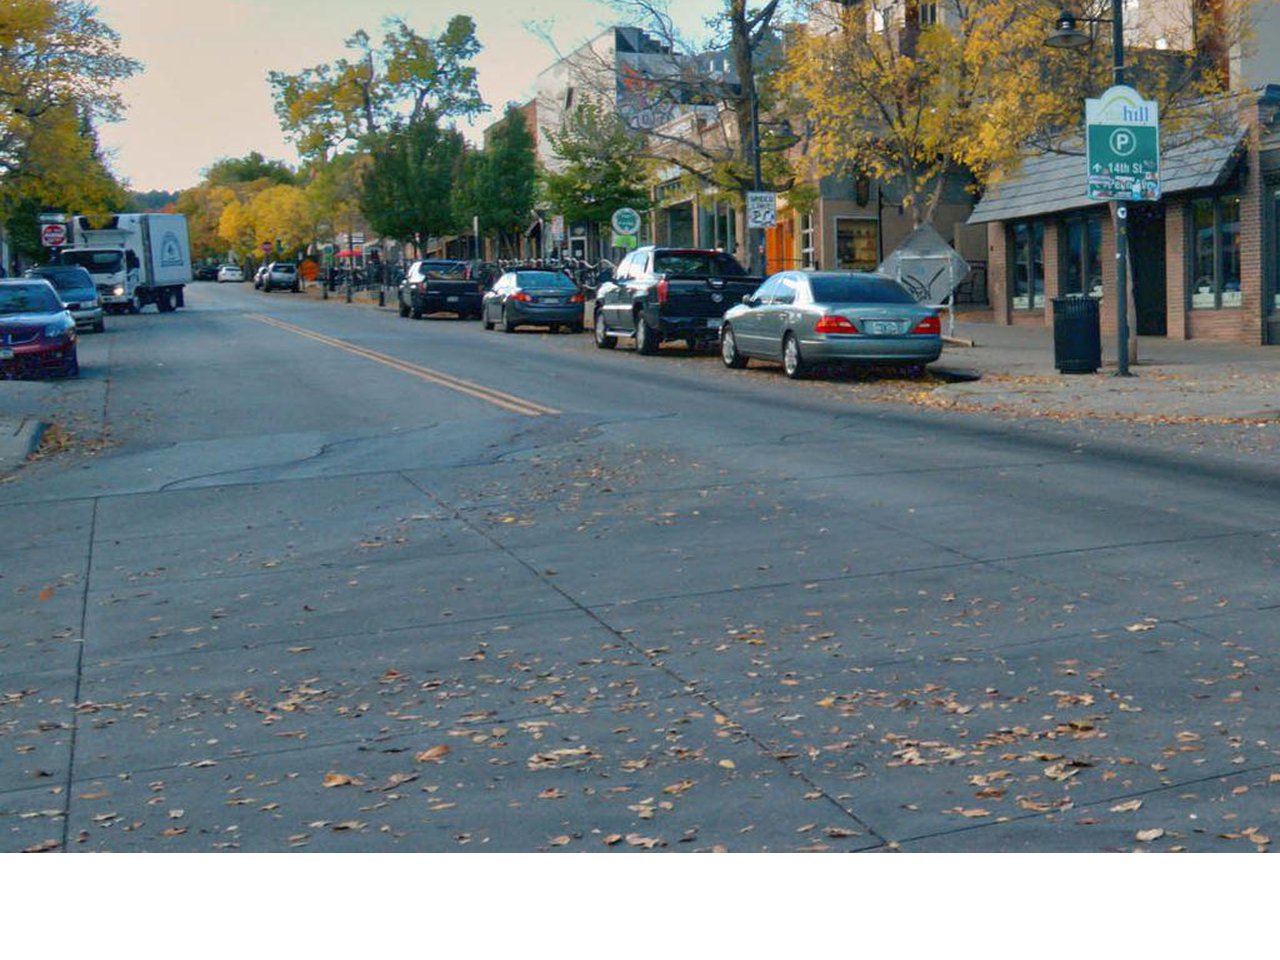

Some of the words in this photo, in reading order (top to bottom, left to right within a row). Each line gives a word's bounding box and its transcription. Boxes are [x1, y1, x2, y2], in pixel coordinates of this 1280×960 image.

[1123, 106, 1149, 122] hill
[1108, 163, 1130, 173] 14th
[1132, 163, 1143, 173] St
